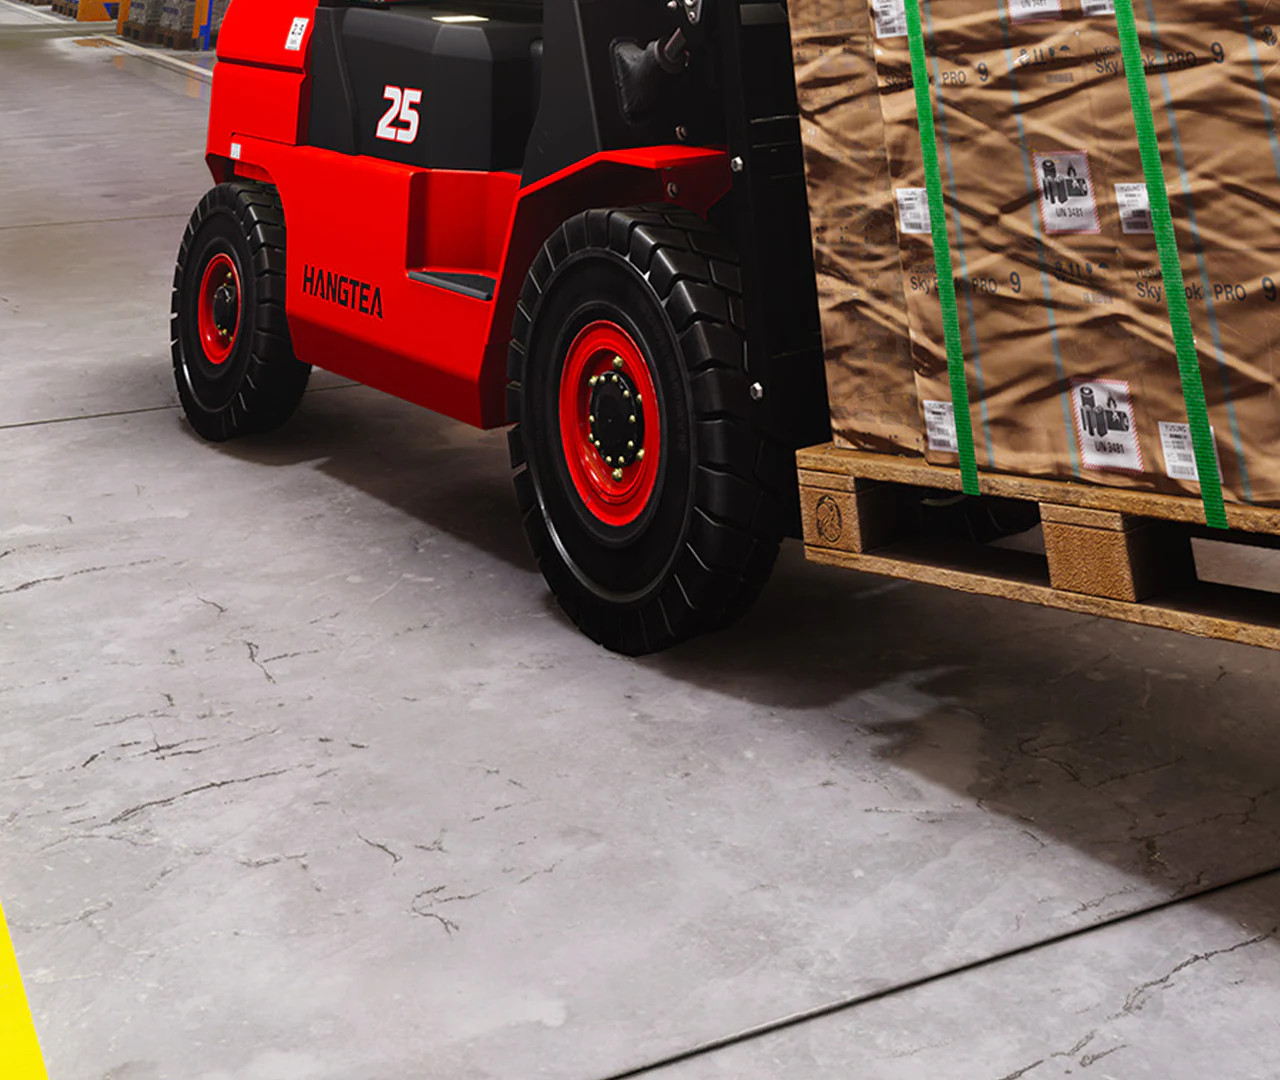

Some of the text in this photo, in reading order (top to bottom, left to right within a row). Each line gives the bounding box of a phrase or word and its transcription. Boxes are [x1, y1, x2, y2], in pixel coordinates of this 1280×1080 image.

[1095, 58, 1118, 75] Sky
[1166, 51, 1197, 68] PRO
[1210, 41, 1225, 64] 9
[942, 70, 967, 86] PRO
[977, 62, 989, 82] 9
[375, 84, 423, 145] 25
[1055, 208, 1066, 218] UN
[302, 263, 383, 319] HANGTEA
[910, 276, 931, 294] Sky
[971, 277, 998, 294] PRO
[1009, 271, 1021, 294] 9
[1136, 281, 1162, 301] Sky
[1213, 282, 1248, 302] PRO
[1261, 276, 1278, 302] 9
[1094, 440, 1107, 451] UN
